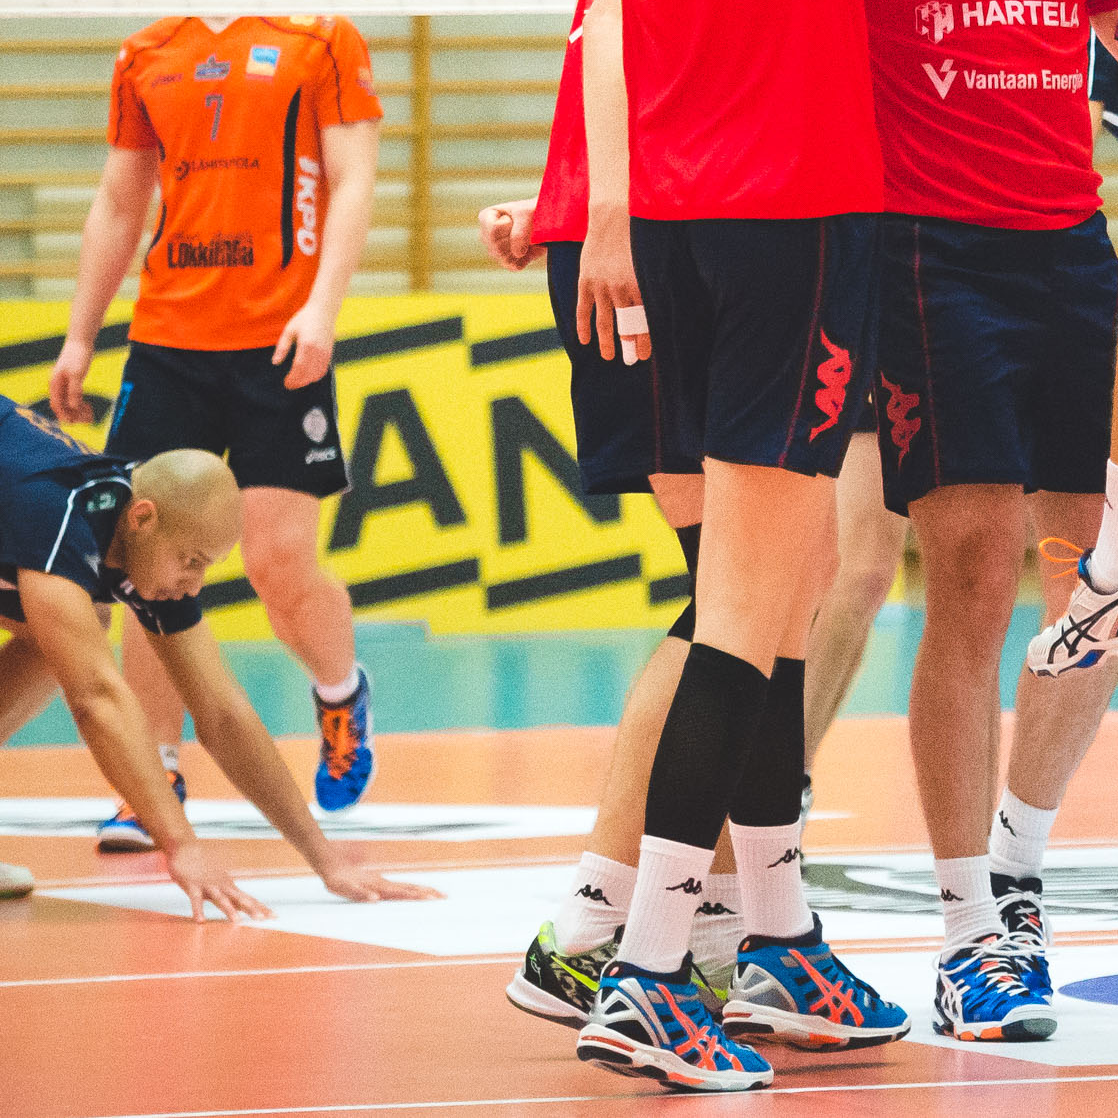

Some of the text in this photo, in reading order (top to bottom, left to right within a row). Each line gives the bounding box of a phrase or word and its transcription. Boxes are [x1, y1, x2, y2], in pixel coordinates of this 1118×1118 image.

[961, 0, 1081, 28] HARTELA
[963, 69, 1038, 90] Vantaan
[204, 93, 224, 142] 7
